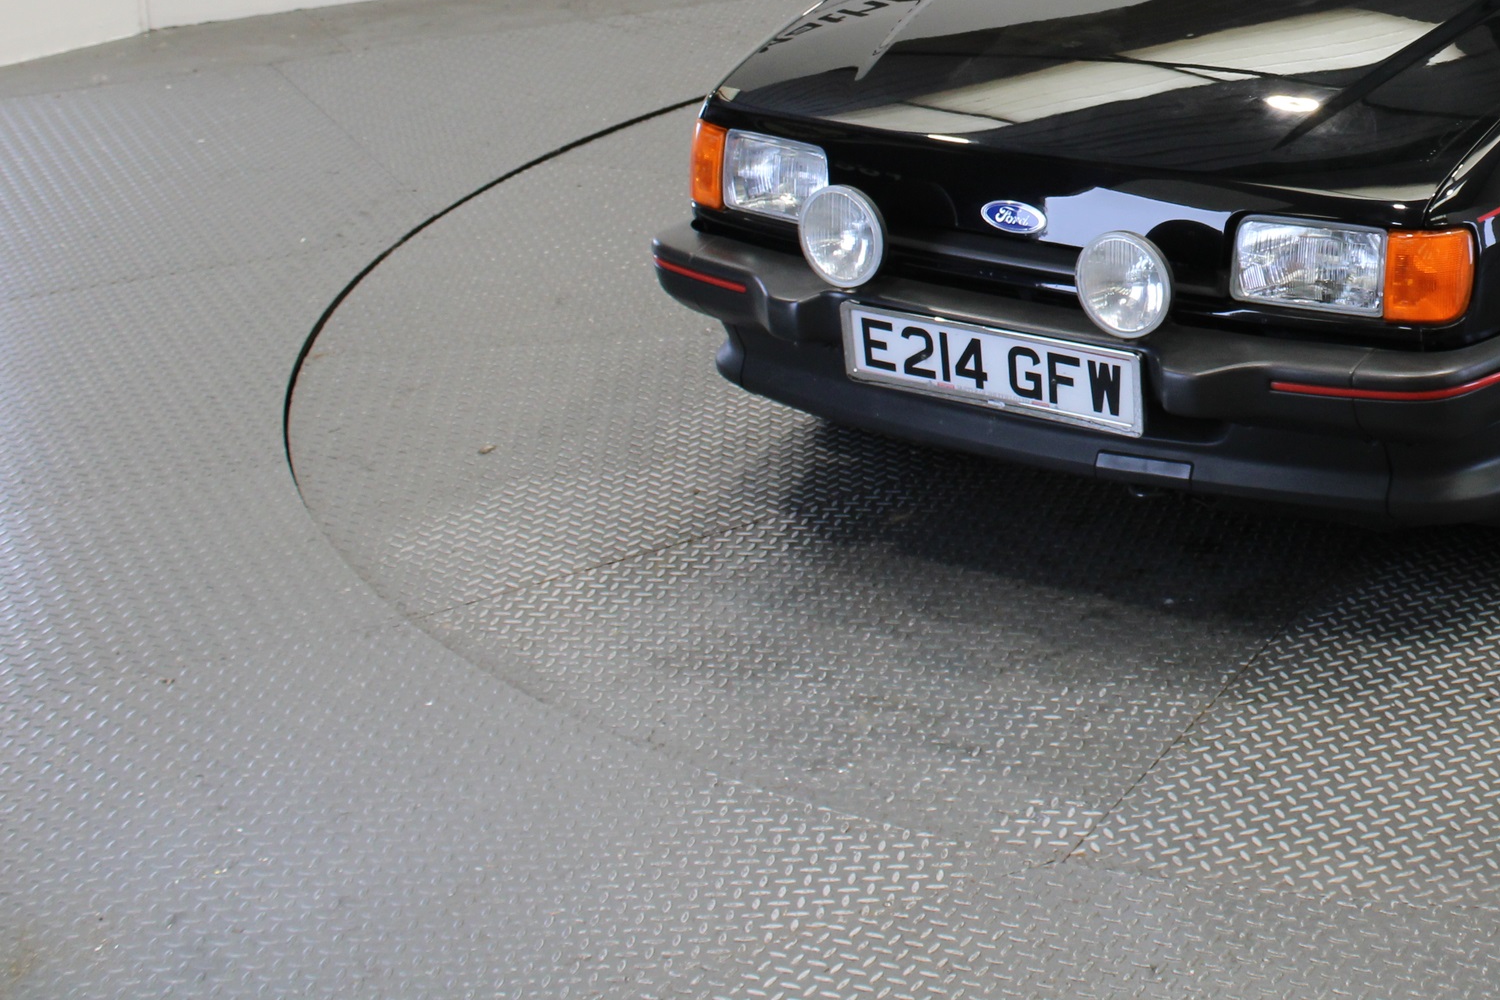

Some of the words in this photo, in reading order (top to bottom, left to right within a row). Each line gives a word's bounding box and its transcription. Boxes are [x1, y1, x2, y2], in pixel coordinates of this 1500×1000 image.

[995, 206, 1030, 226] Ford
[861, 317, 988, 390] E214
[1008, 346, 1121, 416] GFW
